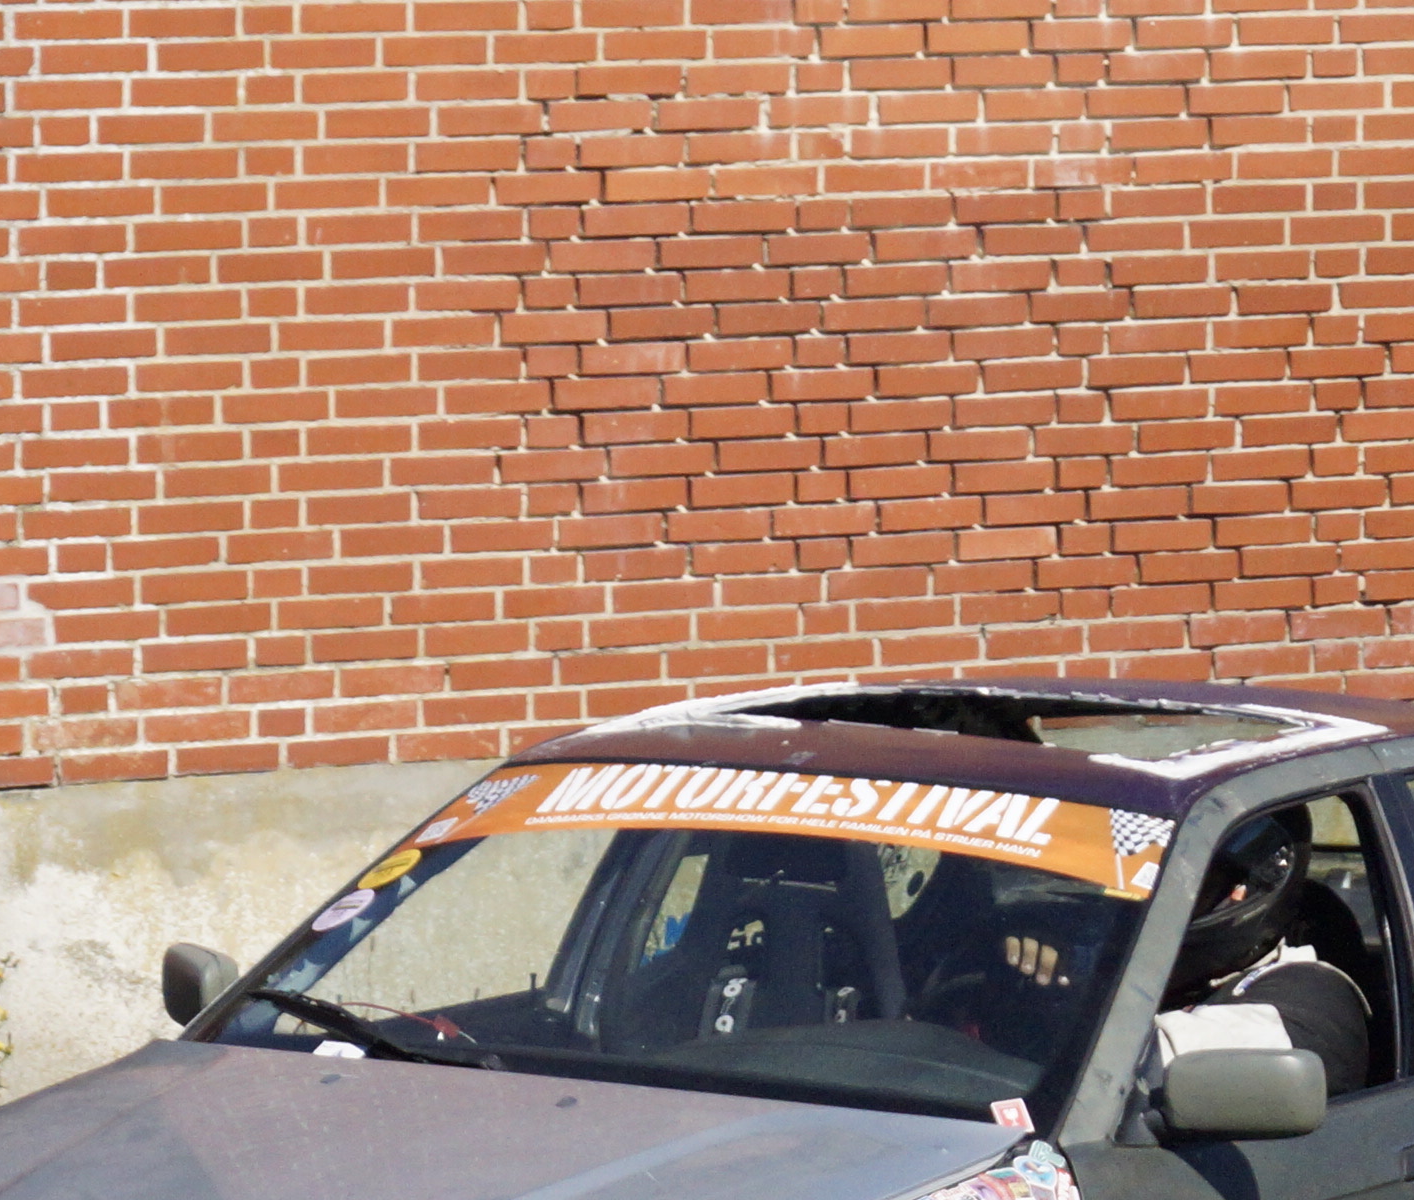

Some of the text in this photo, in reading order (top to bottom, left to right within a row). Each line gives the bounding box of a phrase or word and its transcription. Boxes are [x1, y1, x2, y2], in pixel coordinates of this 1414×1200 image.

[524, 813, 606, 826] DANMARKS
[668, 811, 767, 824] MOTORSHOW
[767, 813, 807, 827] FOR
[807, 817, 839, 830] HELE
[838, 820, 910, 837] FAMILIEN
[910, 828, 935, 840] PÅ
[934, 832, 996, 850] STRUER
[995, 841, 1043, 858] HAVN
[536, 763, 1061, 846] MOTORFESTIVAL
